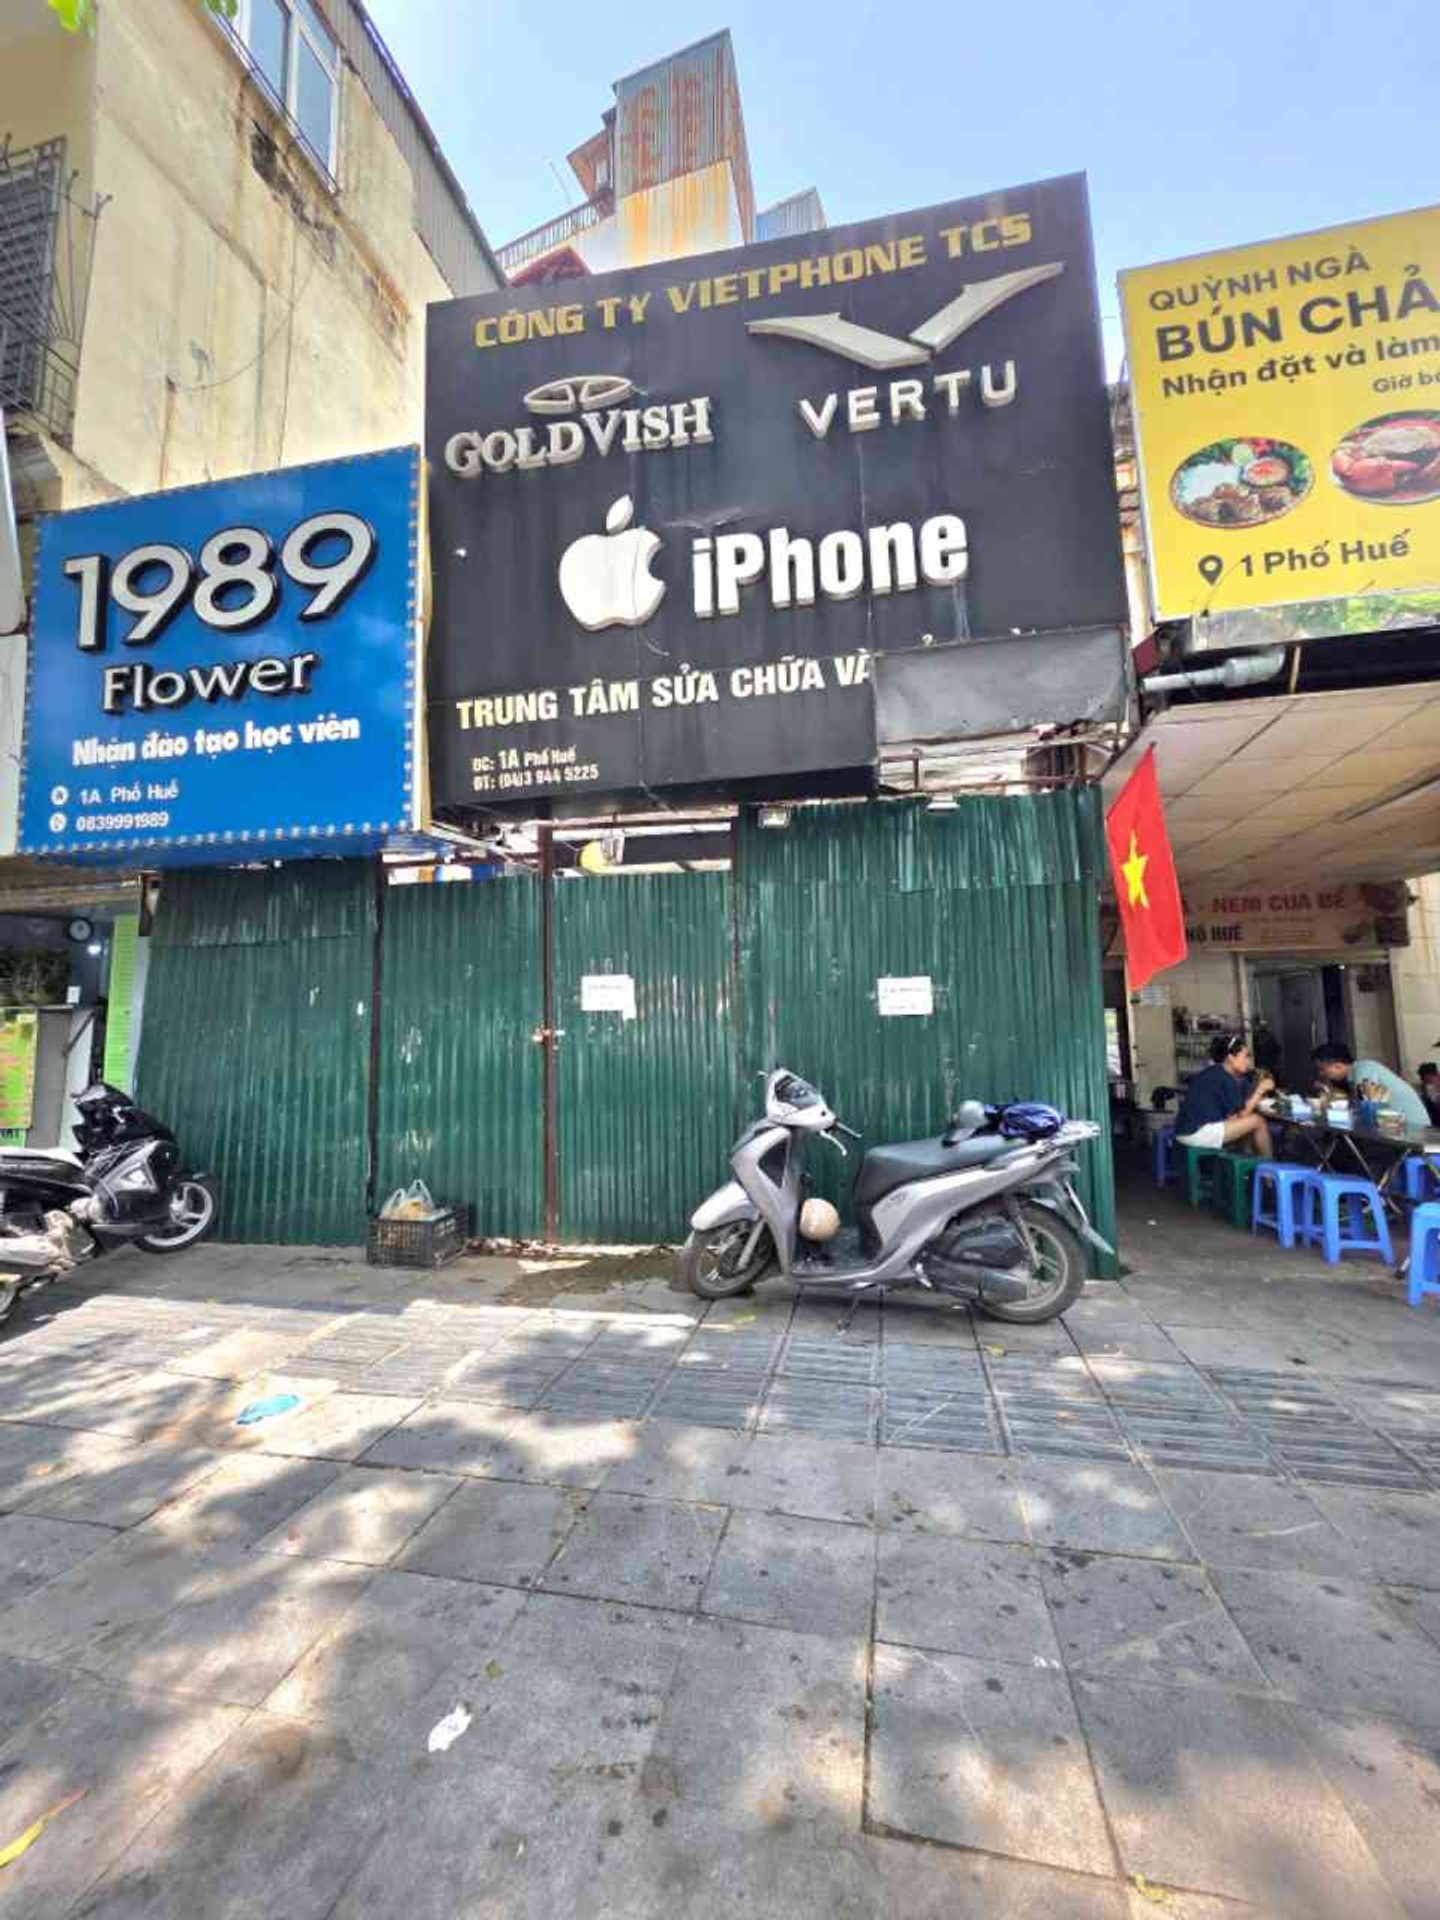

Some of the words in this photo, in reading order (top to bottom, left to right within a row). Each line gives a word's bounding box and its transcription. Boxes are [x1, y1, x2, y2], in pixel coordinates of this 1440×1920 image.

[474, 303, 586, 347] CÔNG
[598, 291, 651, 328] TY
[667, 235, 927, 313] VIETPHONE
[939, 213, 1032, 258] TCS
[1149, 266, 1279, 312] QUỲNH
[1287, 245, 1370, 287] NGÀ
[1155, 305, 1282, 362] BÚN
[1300, 263, 1440, 334] CHẢ
[800, 360, 1018, 440] VERTU
[1162, 360, 1248, 398] Nhận
[1257, 353, 1317, 383] đặt
[1324, 342, 1367, 369] và
[445, 397, 714, 479] GOLDVISH
[63, 511, 376, 650] 1989
[692, 513, 968, 619] iPhone
[1241, 555, 1255, 578] 1
[1264, 539, 1331, 575] Phố
[1340, 528, 1412, 565] Huế
[102, 653, 318, 713] Flower
[456, 691, 559, 730] TRUNG
[569, 678, 640, 717] TÂM
[651, 662, 719, 708] SỬA
[731, 655, 826, 698] CHỮA
[194, 728, 240, 760] tạo
[244, 720, 293, 753] học
[298, 711, 361, 744] viên
[498, 748, 520, 769] 1A
[80, 788, 101, 804] 1A
[563, 764, 600, 781] 5225
